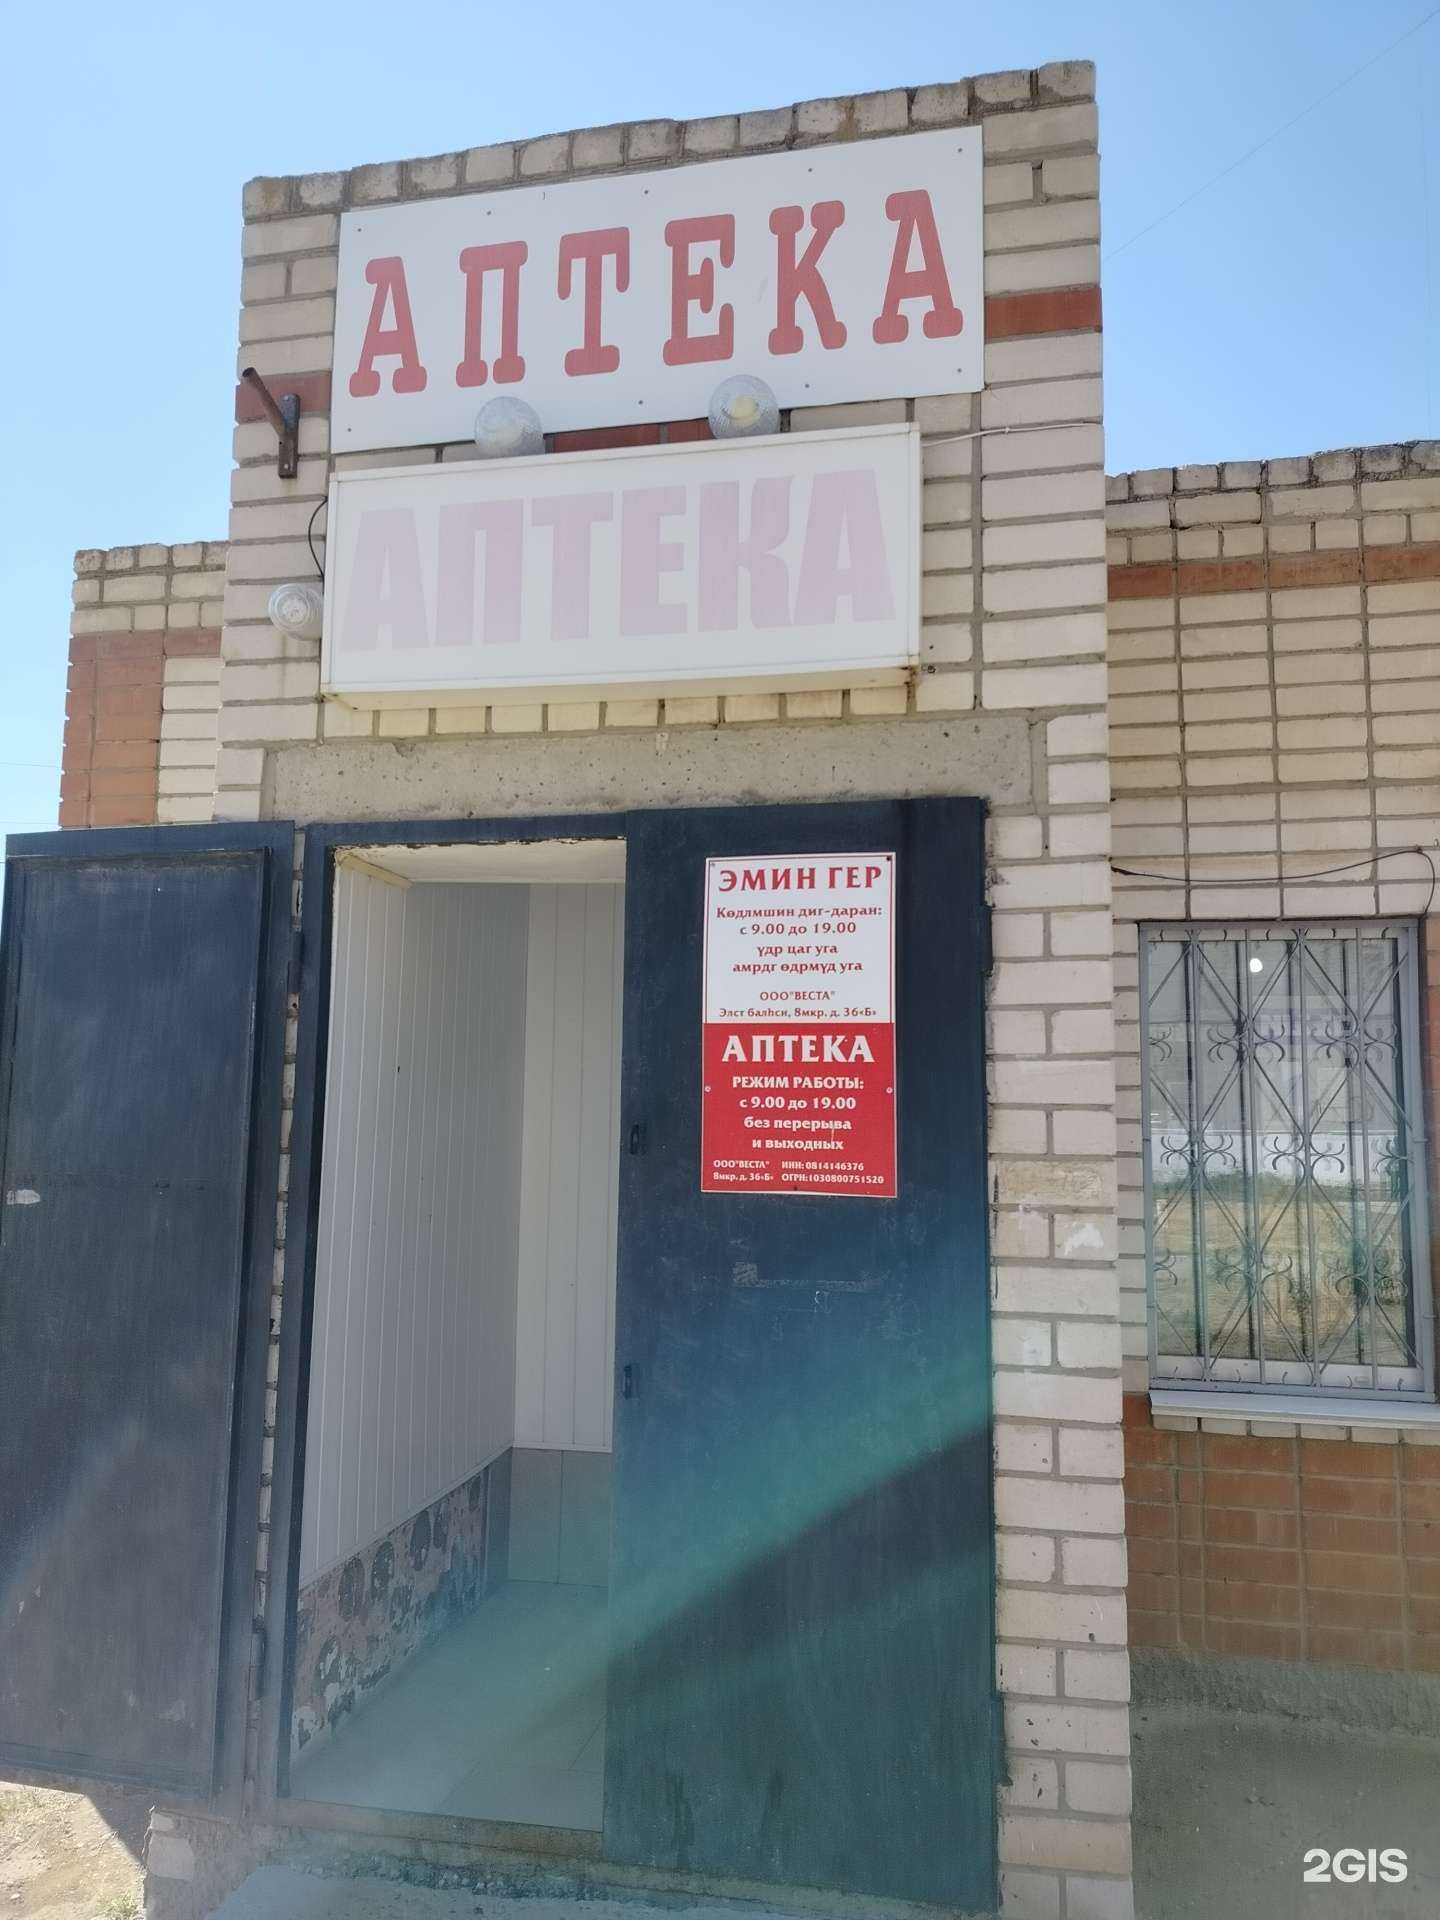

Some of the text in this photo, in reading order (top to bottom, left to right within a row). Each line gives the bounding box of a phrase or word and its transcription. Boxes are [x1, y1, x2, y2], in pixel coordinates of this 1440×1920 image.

[348, 189, 963, 397] АПТЕКА
[341, 468, 896, 652] АПТЕКА
[719, 866, 881, 892] ЭМИН ГЕР
[717, 906, 882, 920] Көдлмшин диг-даран:
[740, 922, 856, 936] с 9.00 до 19.00
[787, 945, 811, 956] цаг
[815, 944, 837, 956] уга
[733, 962, 775, 975] амрдг
[840, 961, 862, 973] уга
[720, 1008, 744, 1017] Элст
[794, 1007, 827, 1019] 8мкр.
[830, 1009, 840, 1018] д.
[722, 1035, 875, 1063] АПТЕКА
[732, 1077, 864, 1089] РЕЖИМ РАБОТЫ:
[739, 1097, 856, 1110] с 9.00 до 19.00
[744, 1117, 852, 1132] без перерыва
[752, 1140, 843, 1151] и выходных
